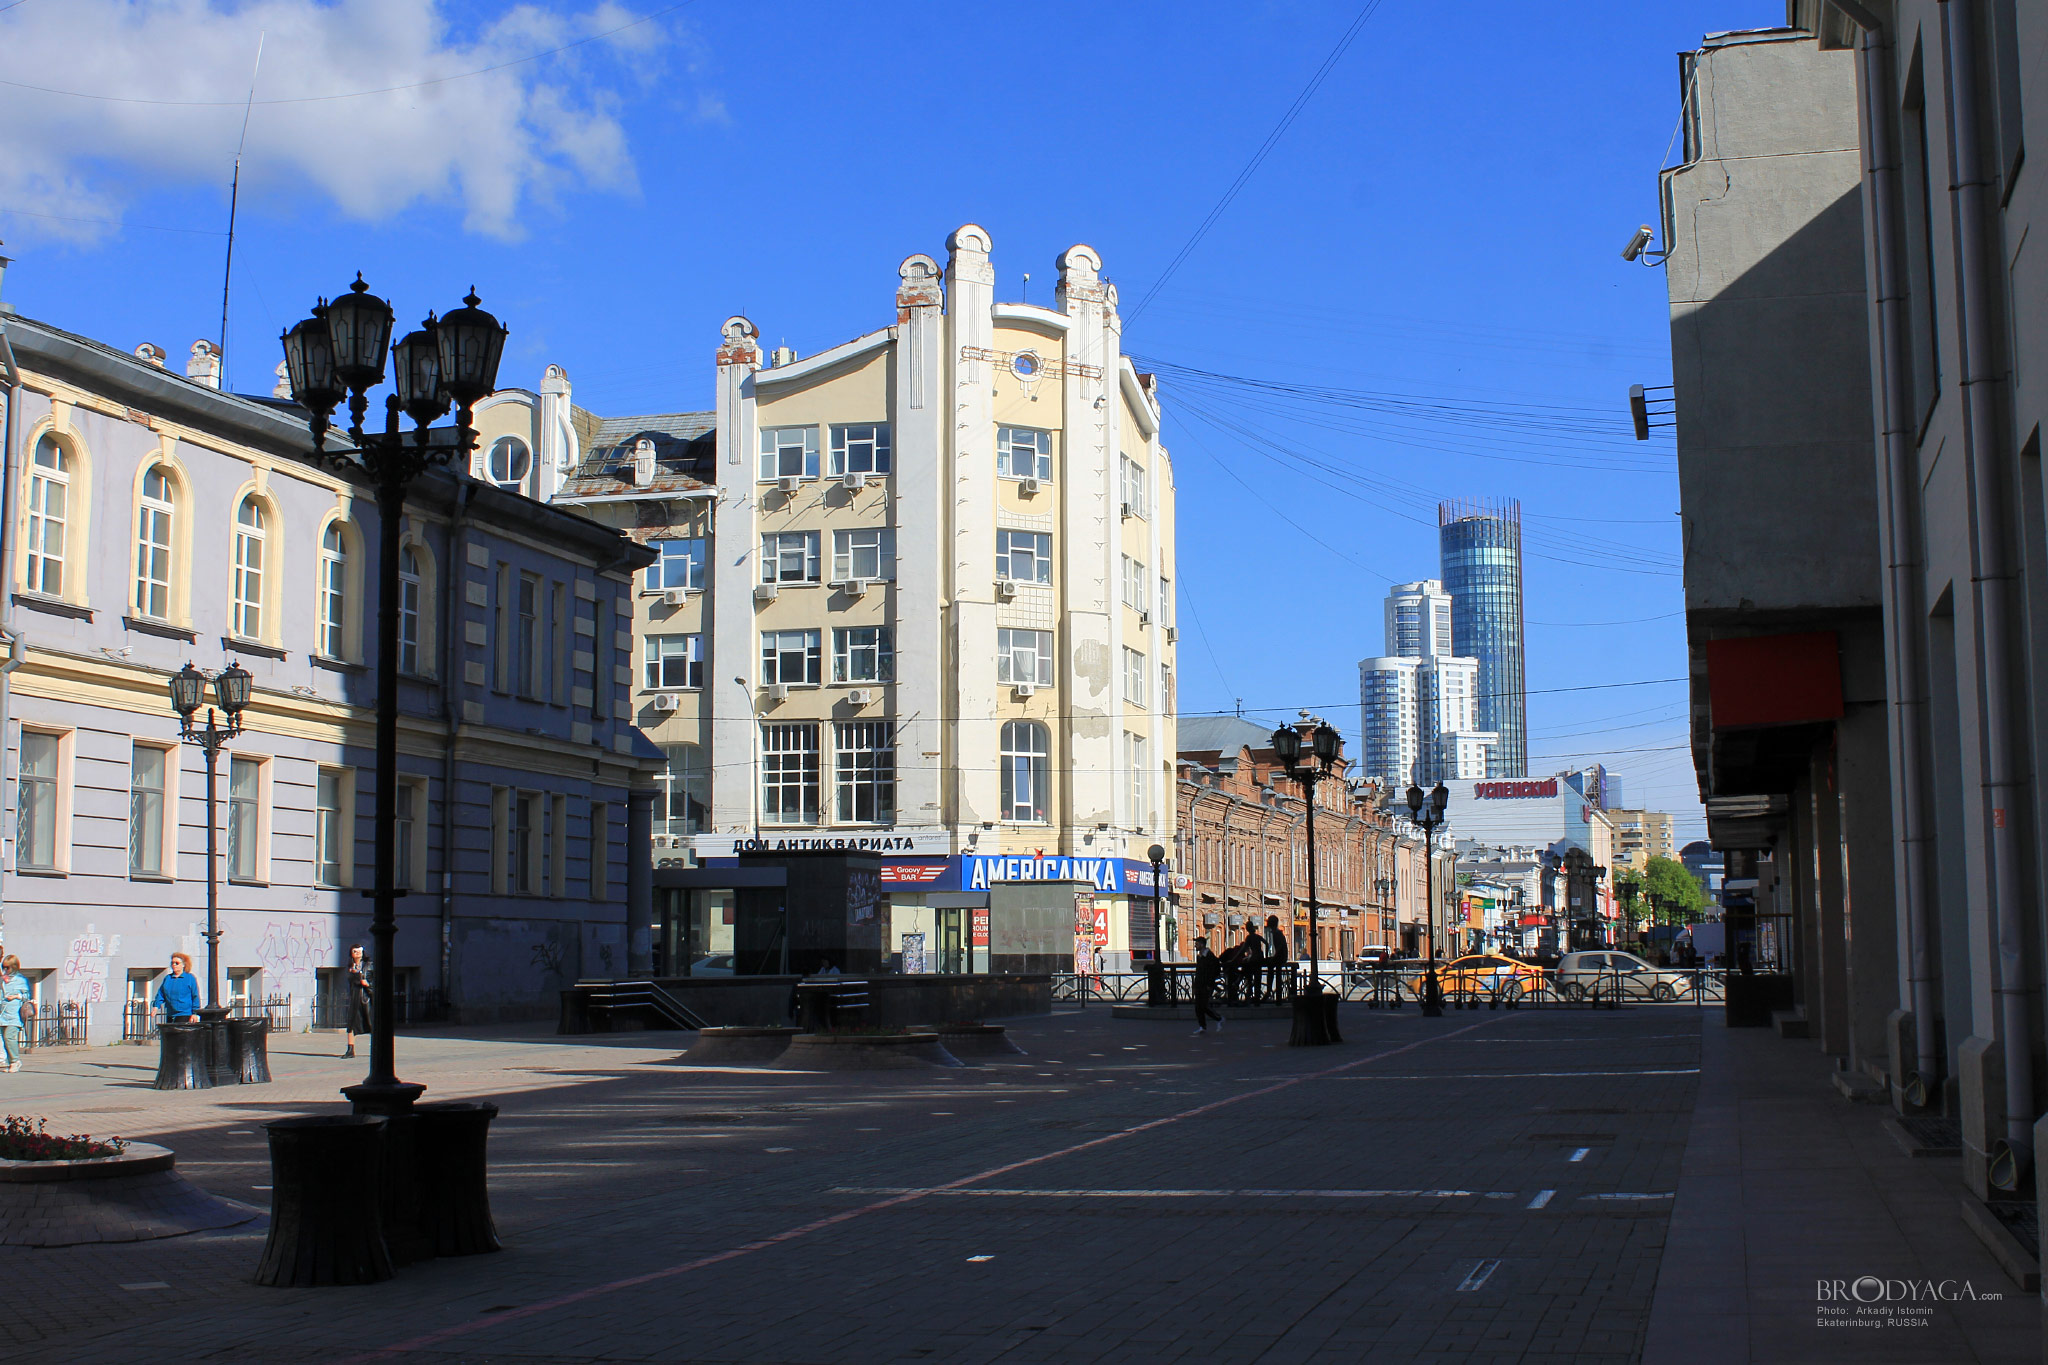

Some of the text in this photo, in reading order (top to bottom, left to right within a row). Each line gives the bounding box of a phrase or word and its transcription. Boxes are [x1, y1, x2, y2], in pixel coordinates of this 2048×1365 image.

[1474, 778, 1557, 799] УСПЕНСКИЙ
[733, 838, 914, 852] ДОМ АНТИКВАРИАТА
[896, 866, 920, 874] Groovy
[970, 858, 1117, 891] AMERICANKA
